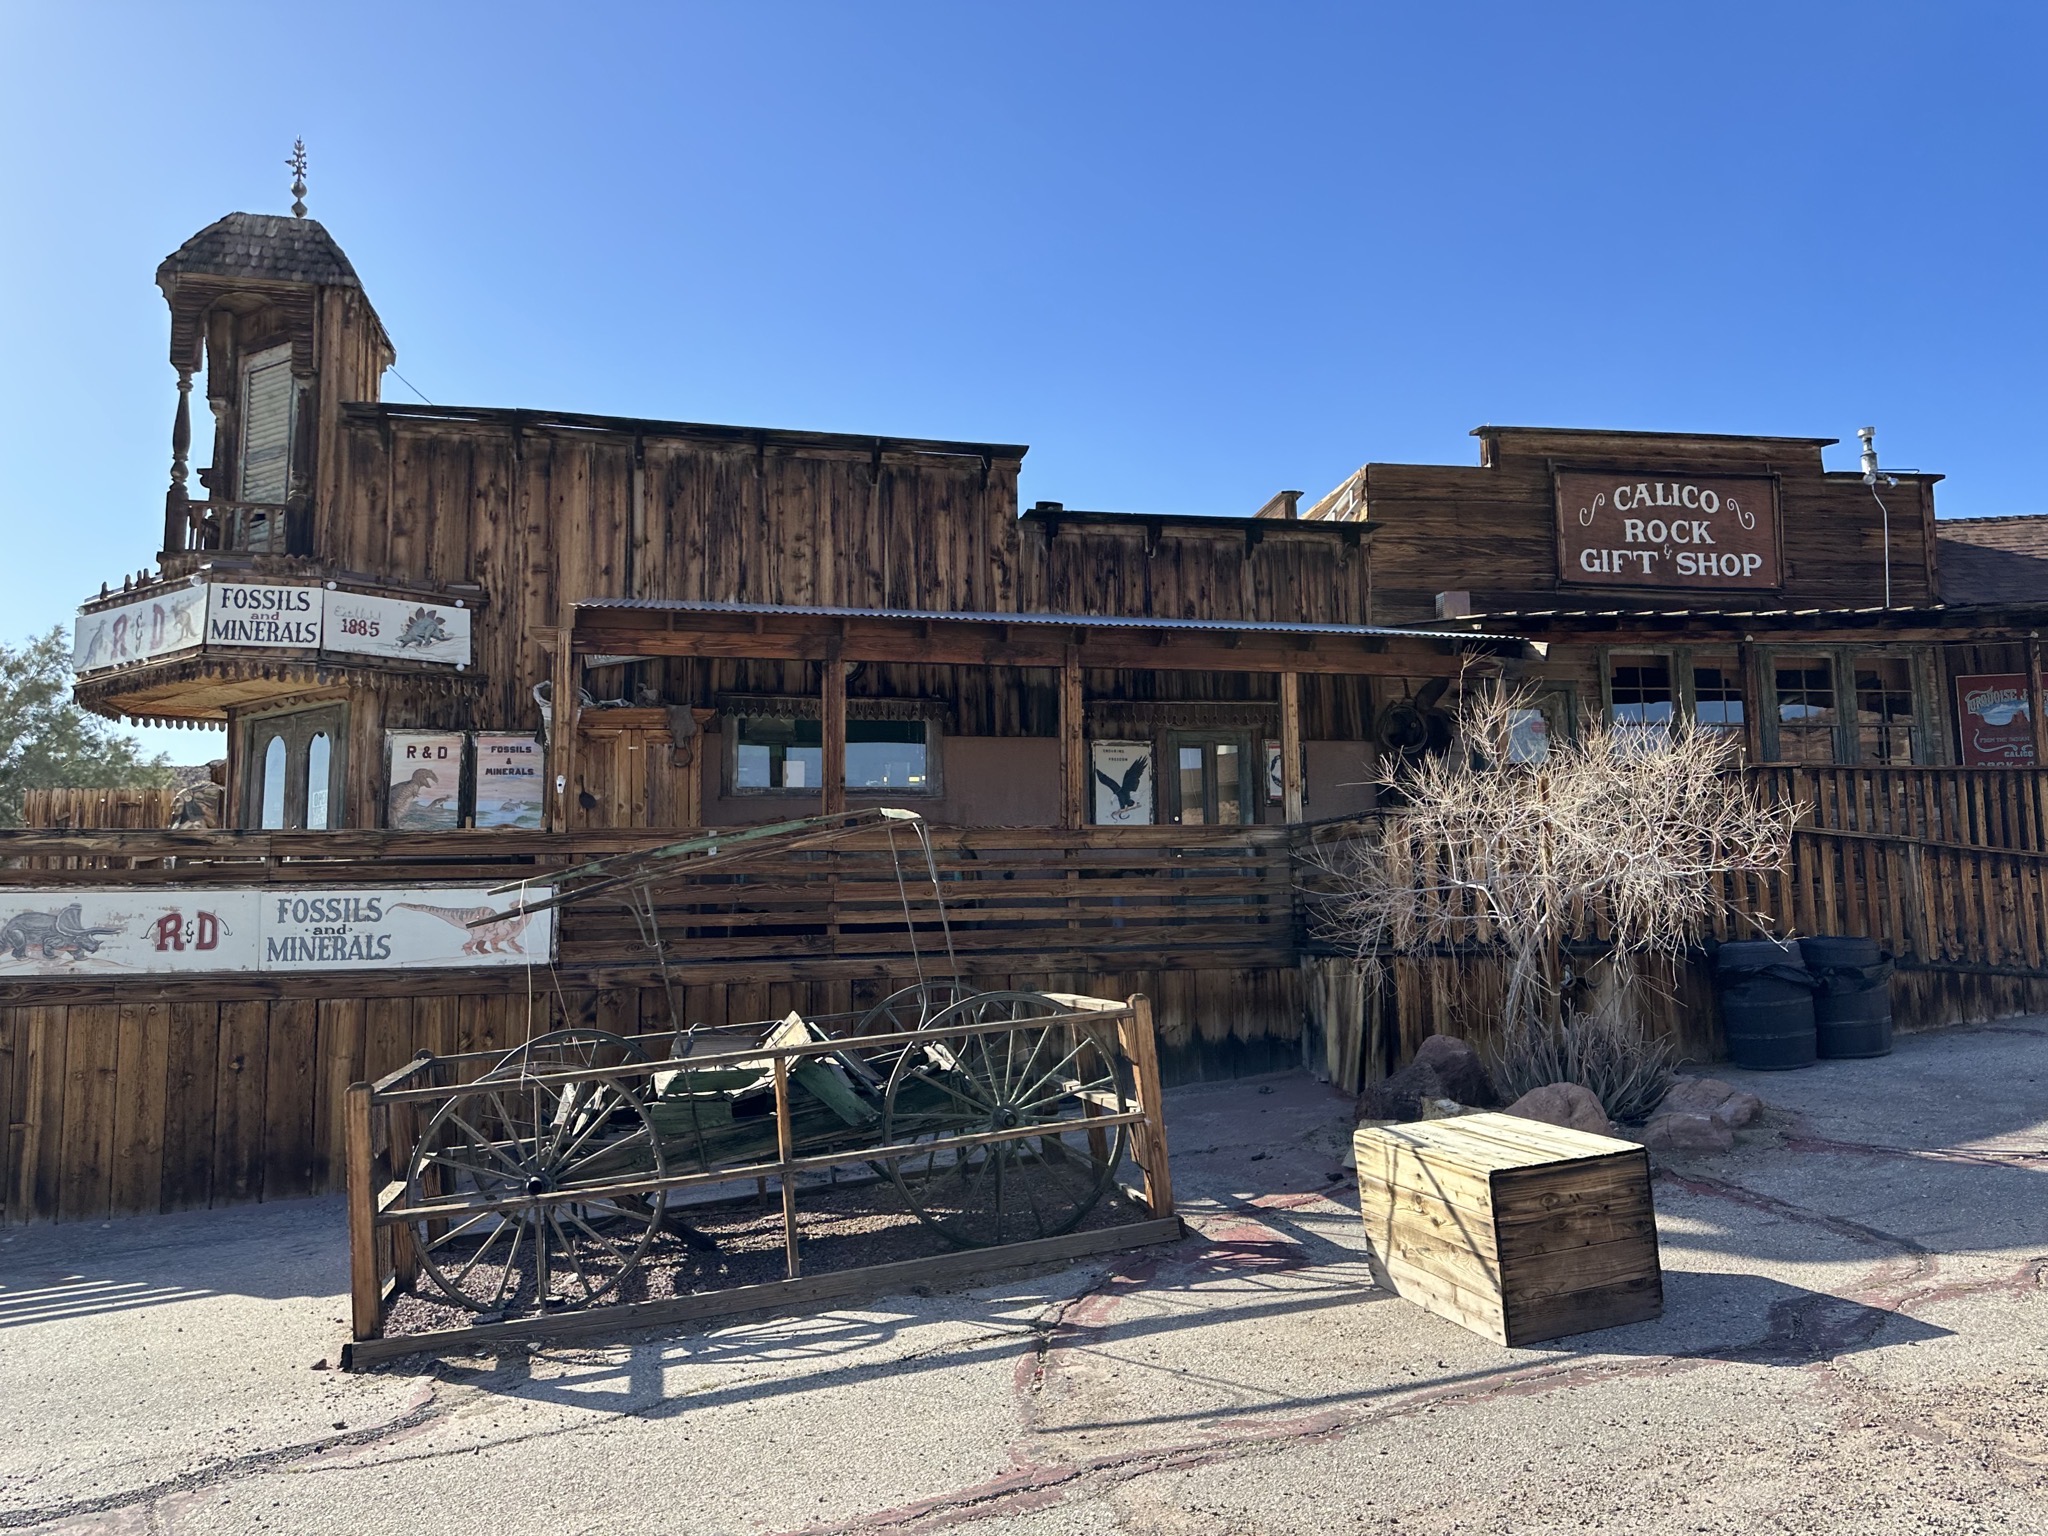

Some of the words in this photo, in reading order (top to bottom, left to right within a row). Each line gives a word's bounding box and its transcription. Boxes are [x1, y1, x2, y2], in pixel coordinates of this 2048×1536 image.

[1613, 482, 1720, 514] CALICO
[1624, 518, 1716, 544] ROCK
[1580, 548, 1659, 574] GIFT
[1676, 551, 1762, 577] SHOP
[221, 588, 310, 612] FOSSILS
[251, 611, 280, 621] and
[341, 618, 380, 637] 1885
[110, 613, 128, 661] R
[149, 603, 165, 650] D
[211, 619, 318, 643] MINERALS
[406, 745, 417, 759] R
[422, 746, 431, 759] &
[438, 746, 447, 759] D
[491, 745, 532, 754] FOSSILS
[506, 757, 512, 765] &
[277, 897, 383, 924] FOSSILS
[312, 924, 347, 936] and
[267, 933, 391, 962] MINERALS
